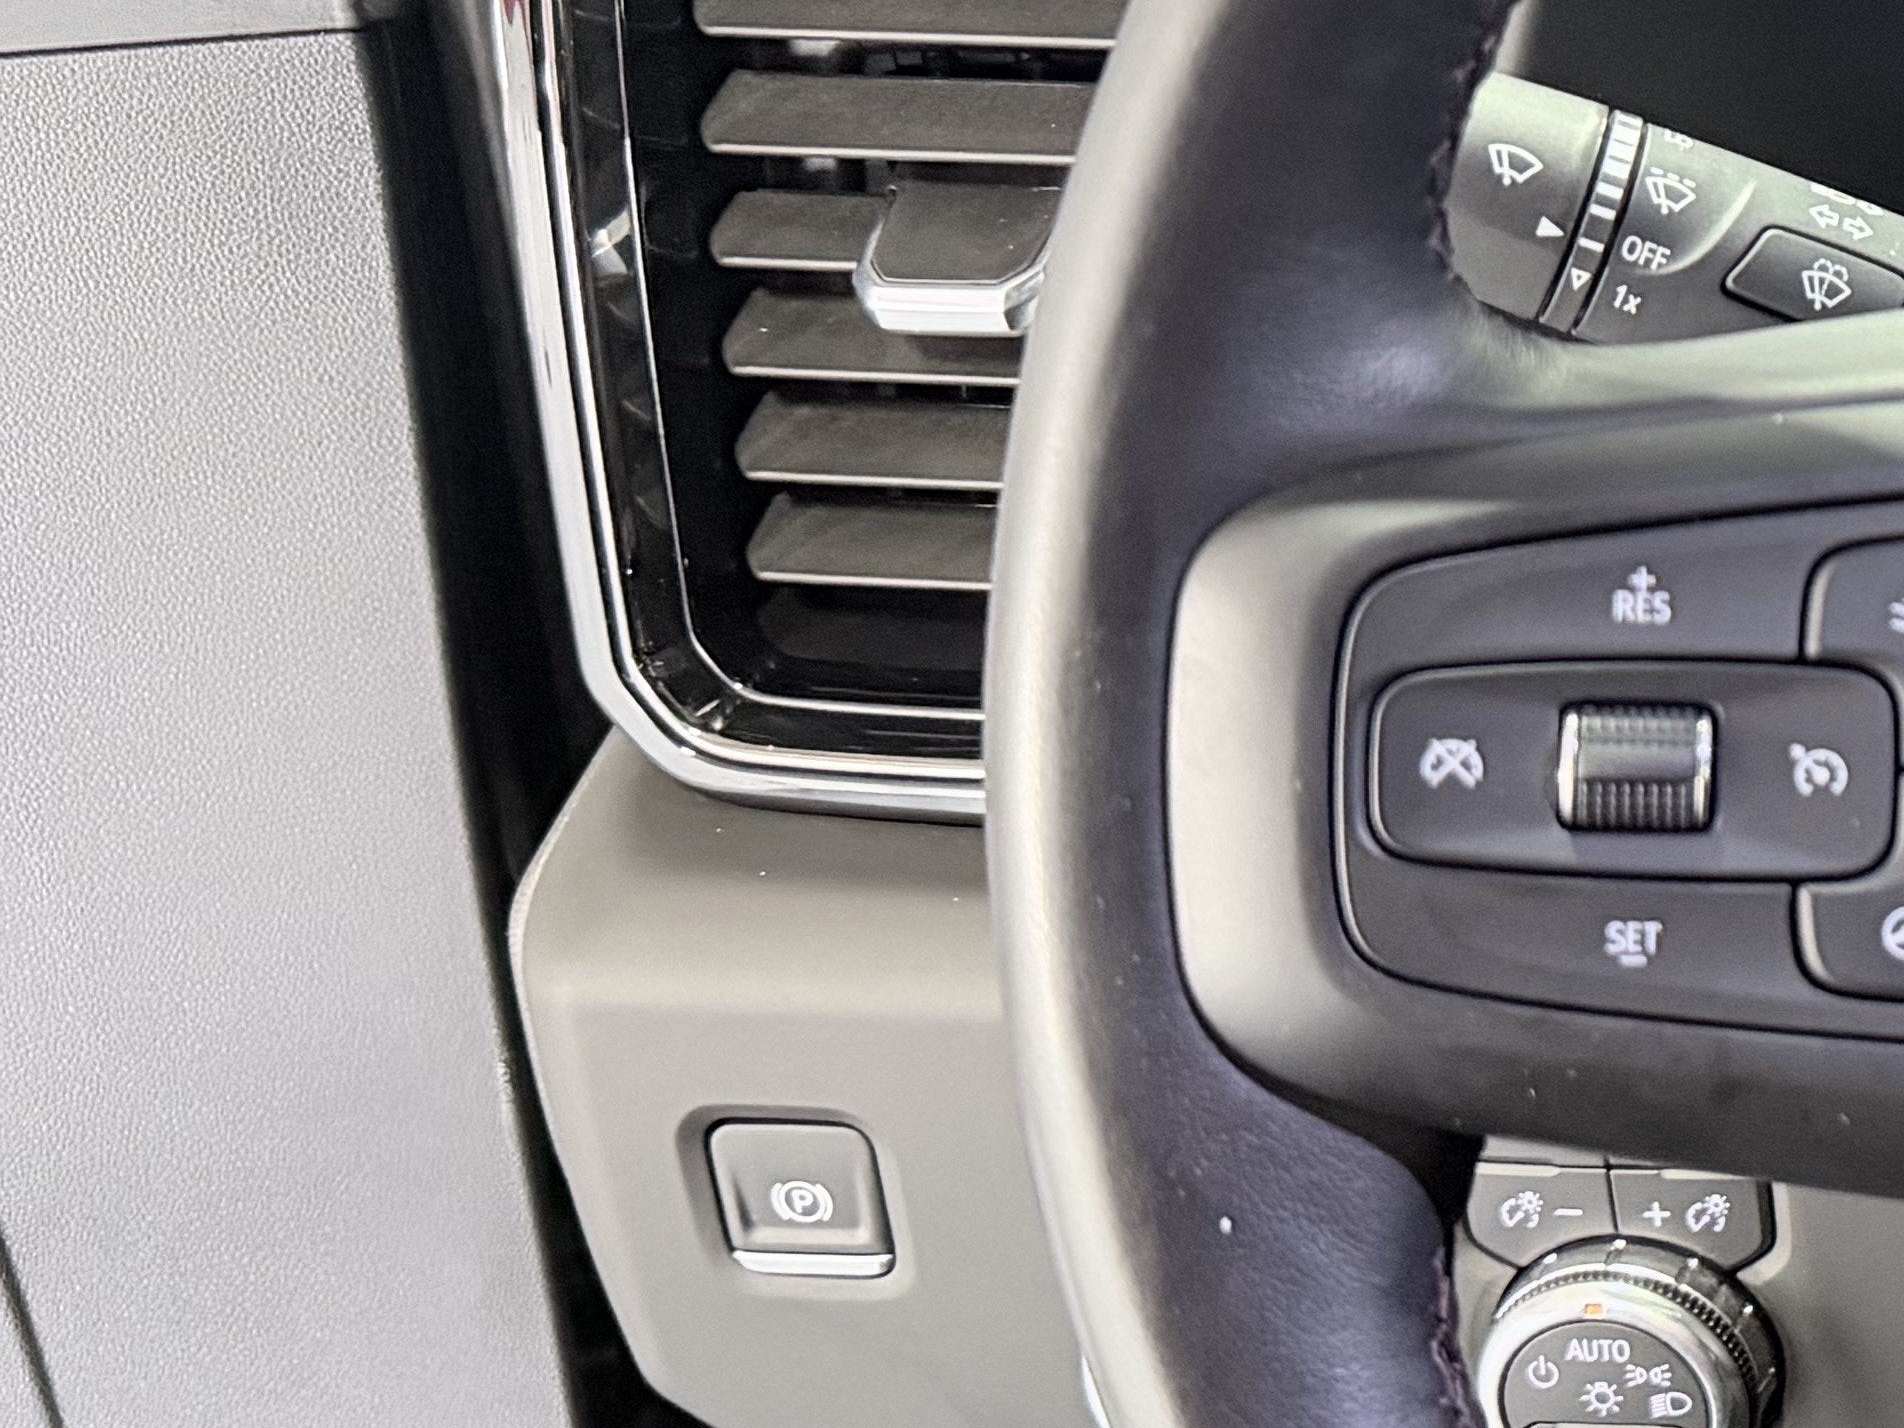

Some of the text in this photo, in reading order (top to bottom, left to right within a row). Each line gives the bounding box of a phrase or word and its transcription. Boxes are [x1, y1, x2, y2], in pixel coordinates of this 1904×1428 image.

[1621, 235, 1672, 272] OFF
[1613, 283, 1642, 315] 1x
[1612, 590, 1671, 624] RES
[1605, 920, 1662, 956] SET
[1564, 1337, 1630, 1364] AUTO
